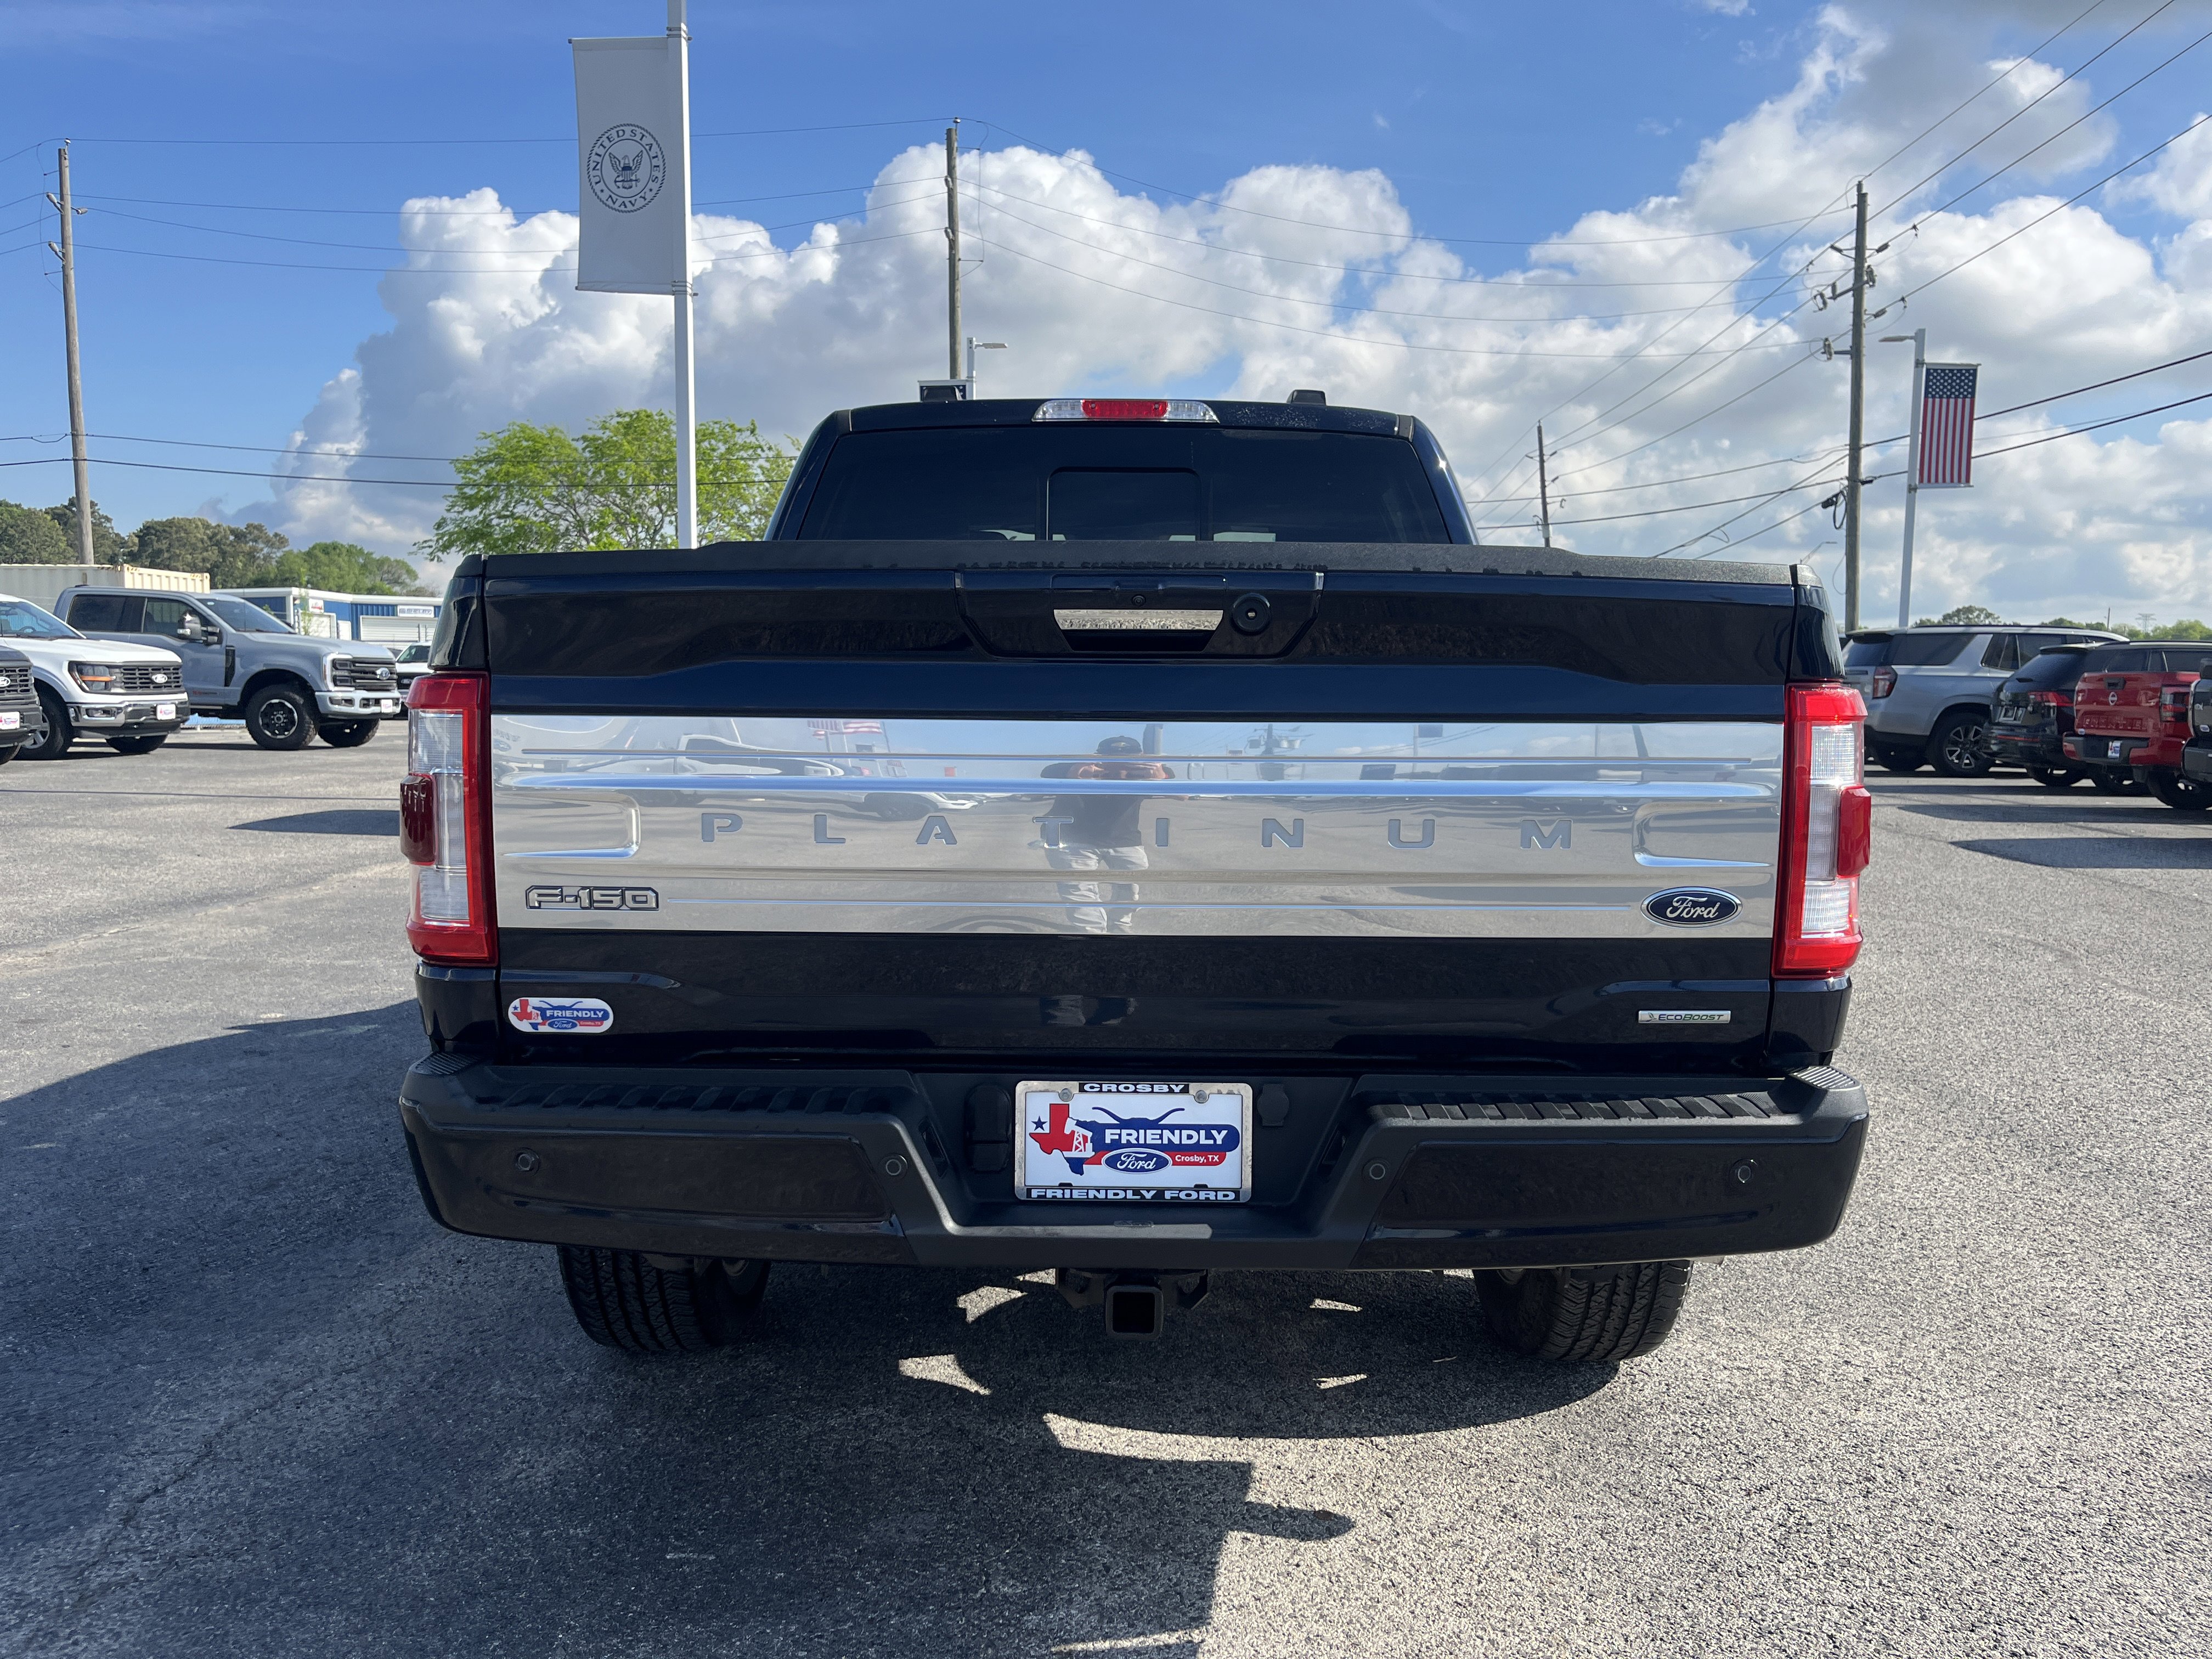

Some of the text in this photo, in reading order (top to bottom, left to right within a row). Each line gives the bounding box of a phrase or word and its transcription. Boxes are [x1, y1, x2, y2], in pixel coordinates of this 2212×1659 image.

[591, 129, 661, 185] UNITED STATES
[606, 191, 648, 208] NAVY
[701, 813, 1573, 849] PLATINUM
[526, 885, 659, 911] F-150
[1666, 896, 1720, 918] Ford
[546, 1009, 604, 1018] FRIENDLY
[553, 1020, 573, 1029] Ford
[1084, 1083, 1185, 1093] CROSBY
[1104, 1129, 1228, 1145] FRIENDLY
[1116, 1153, 1157, 1170] Ford
[1175, 1154, 1206, 1163] Crosby,
[1031, 1188, 1235, 1201] FRIENDLY FORD
